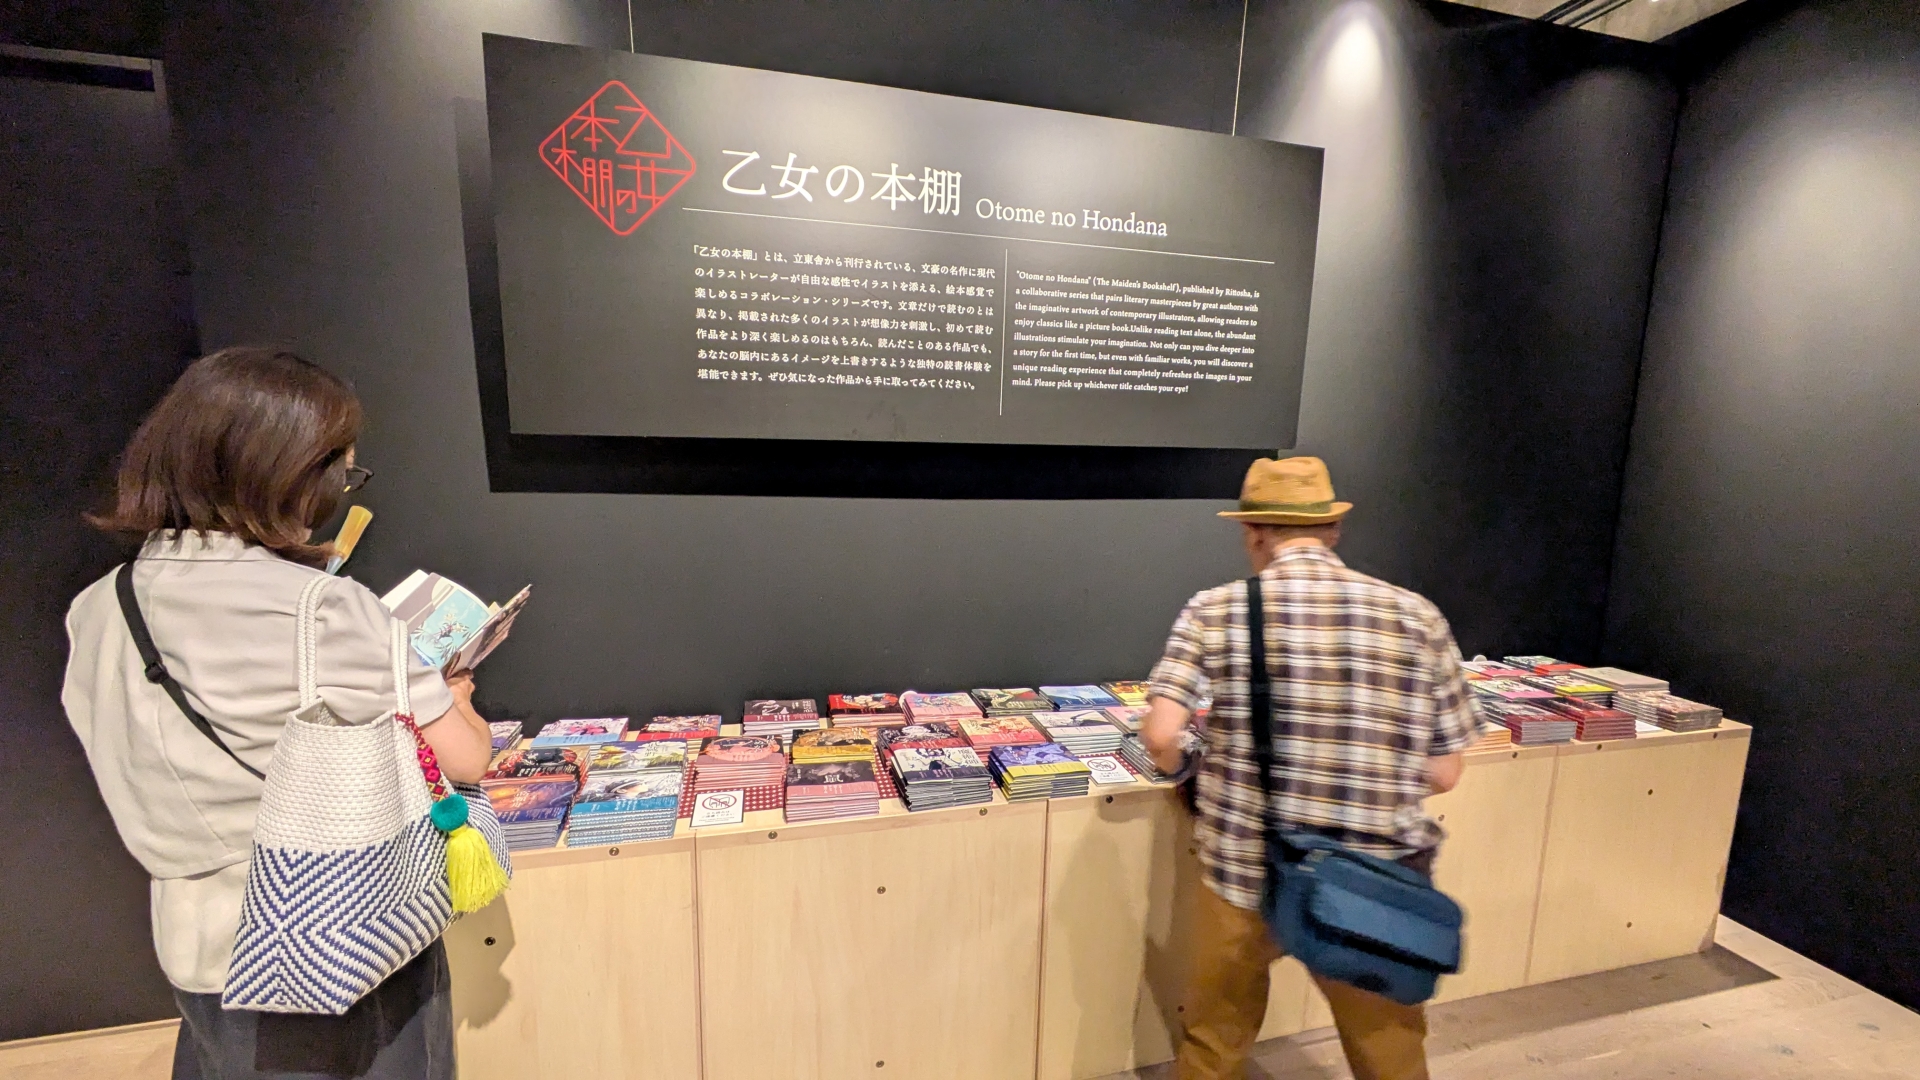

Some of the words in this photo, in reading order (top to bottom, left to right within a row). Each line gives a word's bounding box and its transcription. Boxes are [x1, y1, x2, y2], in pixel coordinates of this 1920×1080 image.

[721, 149, 963, 216] 乙女の本棚
[976, 198, 1044, 223] Otome
[1051, 212, 1076, 226] no
[1082, 210, 1168, 236] Hondana
[1022, 287, 1067, 298] collaborative
[1090, 292, 1104, 300] that
[1105, 294, 1122, 303] pairs
[1124, 294, 1149, 306] literary
[1150, 299, 1192, 308] masterpieces
[1192, 300, 1202, 310] by
[1202, 302, 1218, 310] great
[1219, 302, 1243, 311] authors
[1244, 304, 1258, 312] with
[1182, 285, 1214, 294] published
[1215, 287, 1224, 297] by
[1254, 290, 1260, 298] is
[1015, 302, 1027, 310] the
[1029, 303, 1070, 314] imaginative
[1071, 307, 1099, 315] artwork
[1100, 308, 1110, 316] of
[1110, 310, 1157, 321] contemporary
[1197, 314, 1225, 326] allowing
[1226, 317, 1249, 326] readers
[1014, 318, 1035, 328] enjoy
[1036, 318, 1063, 328] classics
[1064, 320, 1078, 328] like
[1085, 322, 1110, 332] picture
[1154, 326, 1179, 337] reading
[1214, 330, 1226, 338] the
[1226, 331, 1256, 340] abundant
[1014, 332, 1056, 342] illustrations
[1057, 336, 1089, 344] stimulate
[1090, 339, 1107, 347] your
[1164, 342, 1178, 352] only
[1205, 344, 1219, 352] dive
[1220, 344, 1241, 355] deeper
[1242, 346, 1255, 354] into
[1019, 349, 1038, 358] story
[1040, 348, 1050, 357] for
[1052, 349, 1063, 358] the
[1064, 350, 1078, 358] first
[1098, 352, 1110, 360] but
[1128, 354, 1144, 362] with
[1144, 354, 1170, 363] familiar
[1207, 358, 1220, 366] will
[1221, 358, 1248, 368] discover
[1013, 363, 1038, 373] unique
[1040, 364, 1067, 375] reading
[1068, 366, 1106, 376] experience
[1108, 367, 1122, 375] that
[1123, 368, 1161, 379] completely
[1162, 370, 1192, 379] refreshes
[1193, 371, 1204, 379] the
[1205, 372, 1228, 382] images
[1034, 378, 1056, 387] Please
[1057, 380, 1072, 390] pick
[1074, 382, 1083, 390] up
[1084, 380, 1118, 390] whichever
[1119, 382, 1133, 390] title
[1134, 383, 1158, 391] catches
[1158, 386, 1174, 394] your
